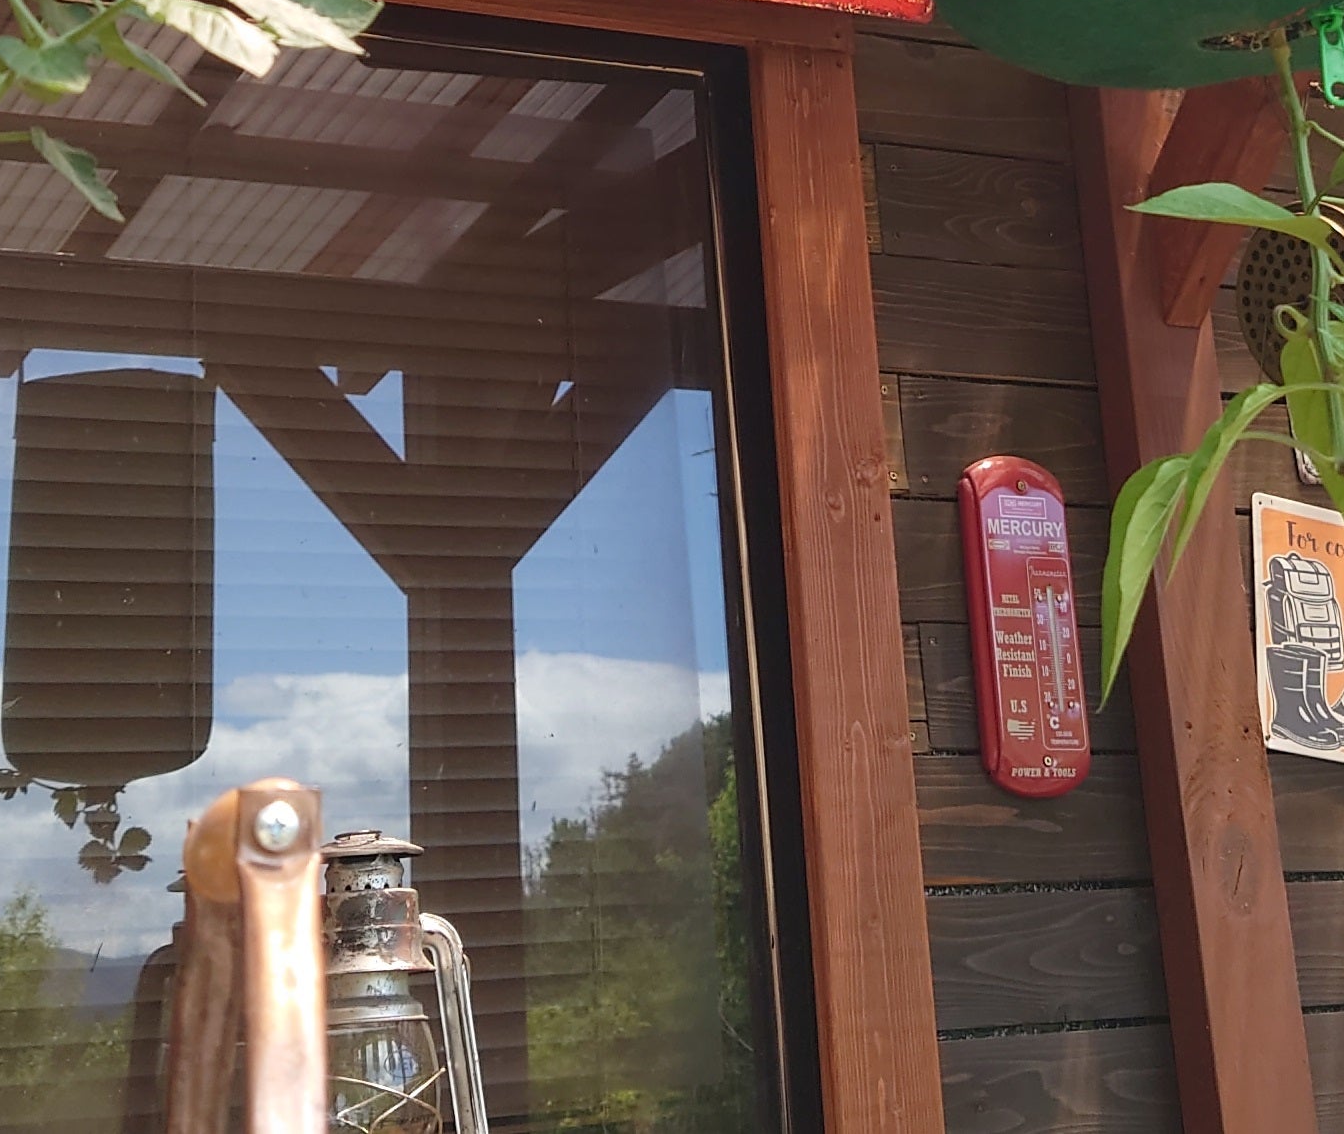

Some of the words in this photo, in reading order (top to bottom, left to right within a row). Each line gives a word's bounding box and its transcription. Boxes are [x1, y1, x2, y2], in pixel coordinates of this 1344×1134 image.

[987, 517, 1063, 537] MERCURY
[1285, 520, 1320, 554] For
[995, 630, 1033, 645] Weather
[1062, 627, 1070, 638] 20
[1039, 639, 1047, 651] 10
[995, 647, 1036, 662] Resistant
[1002, 663, 1033, 678] Finish
[1041, 665, 1049, 677] 10
[1009, 699, 1028, 713] U.S
[1011, 767, 1042, 778] POWER
[1043, 767, 1050, 777] &
[1053, 767, 1077, 778] TOOLS
